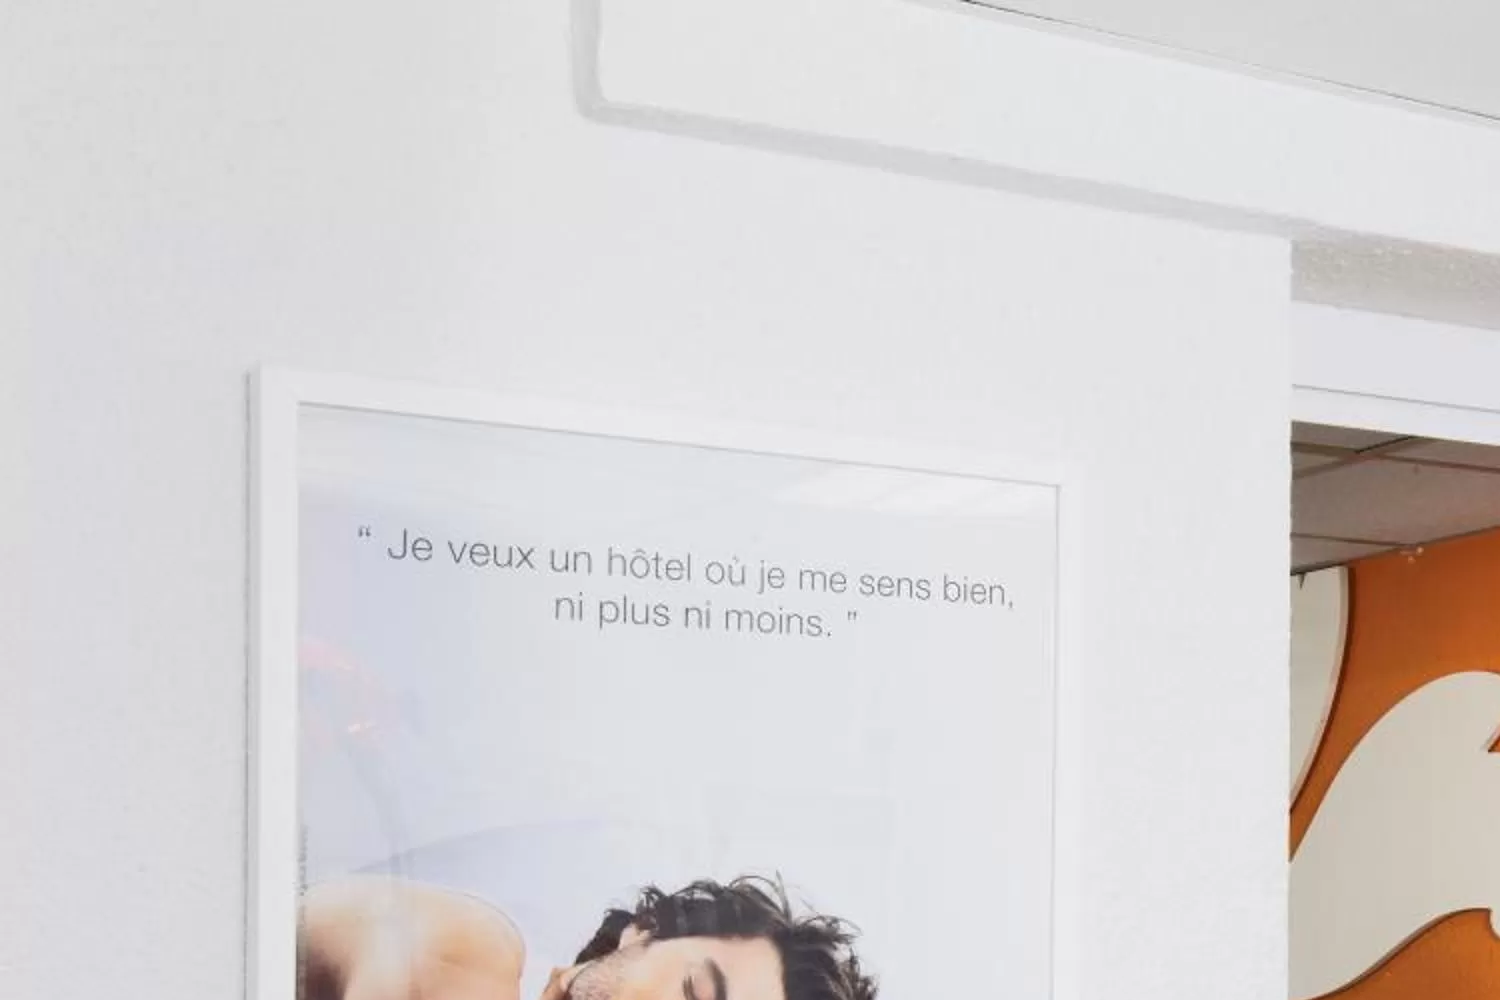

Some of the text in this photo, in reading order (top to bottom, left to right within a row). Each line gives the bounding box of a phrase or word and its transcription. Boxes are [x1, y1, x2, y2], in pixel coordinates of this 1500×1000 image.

[387, 528, 433, 562] Je
[448, 541, 536, 570] veux
[550, 549, 592, 576] un
[607, 546, 692, 582] hôtel
[705, 555, 746, 587] où
[757, 559, 786, 594] je
[799, 567, 848, 594] me
[859, 572, 932, 602] sens
[943, 573, 1014, 610] bien,
[554, 591, 583, 622] ni
[599, 594, 671, 630] plus
[684, 601, 711, 630] ni
[725, 606, 833, 638] moins.
